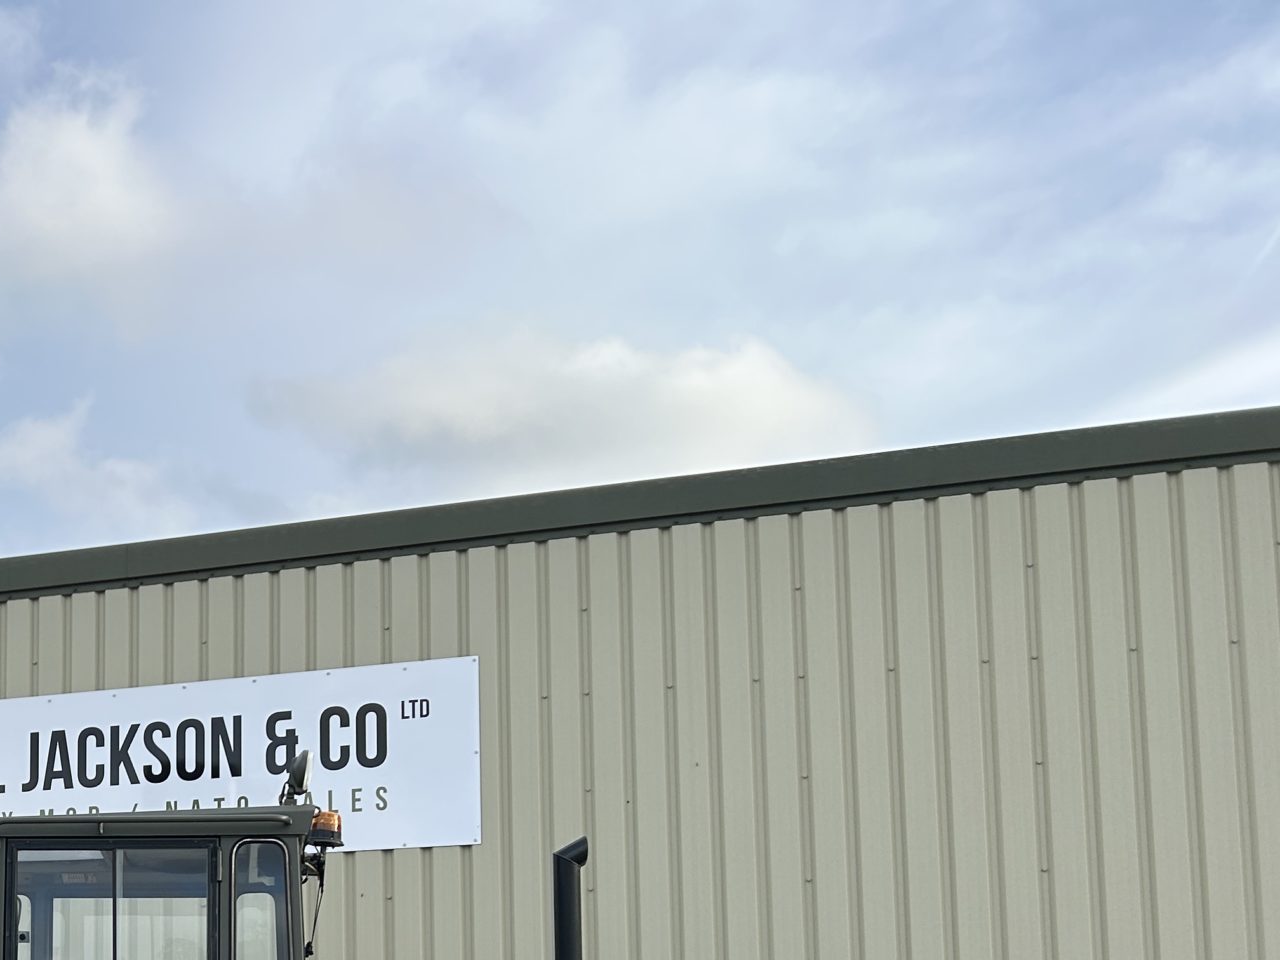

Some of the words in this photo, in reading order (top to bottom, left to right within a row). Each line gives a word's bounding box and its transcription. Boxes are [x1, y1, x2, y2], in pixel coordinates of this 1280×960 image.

[21, 714, 243, 793] JACKSON
[265, 710, 299, 776] &
[319, 702, 388, 771] CO
[400, 698, 430, 720] LTD
[300, 786, 389, 813] ALES
